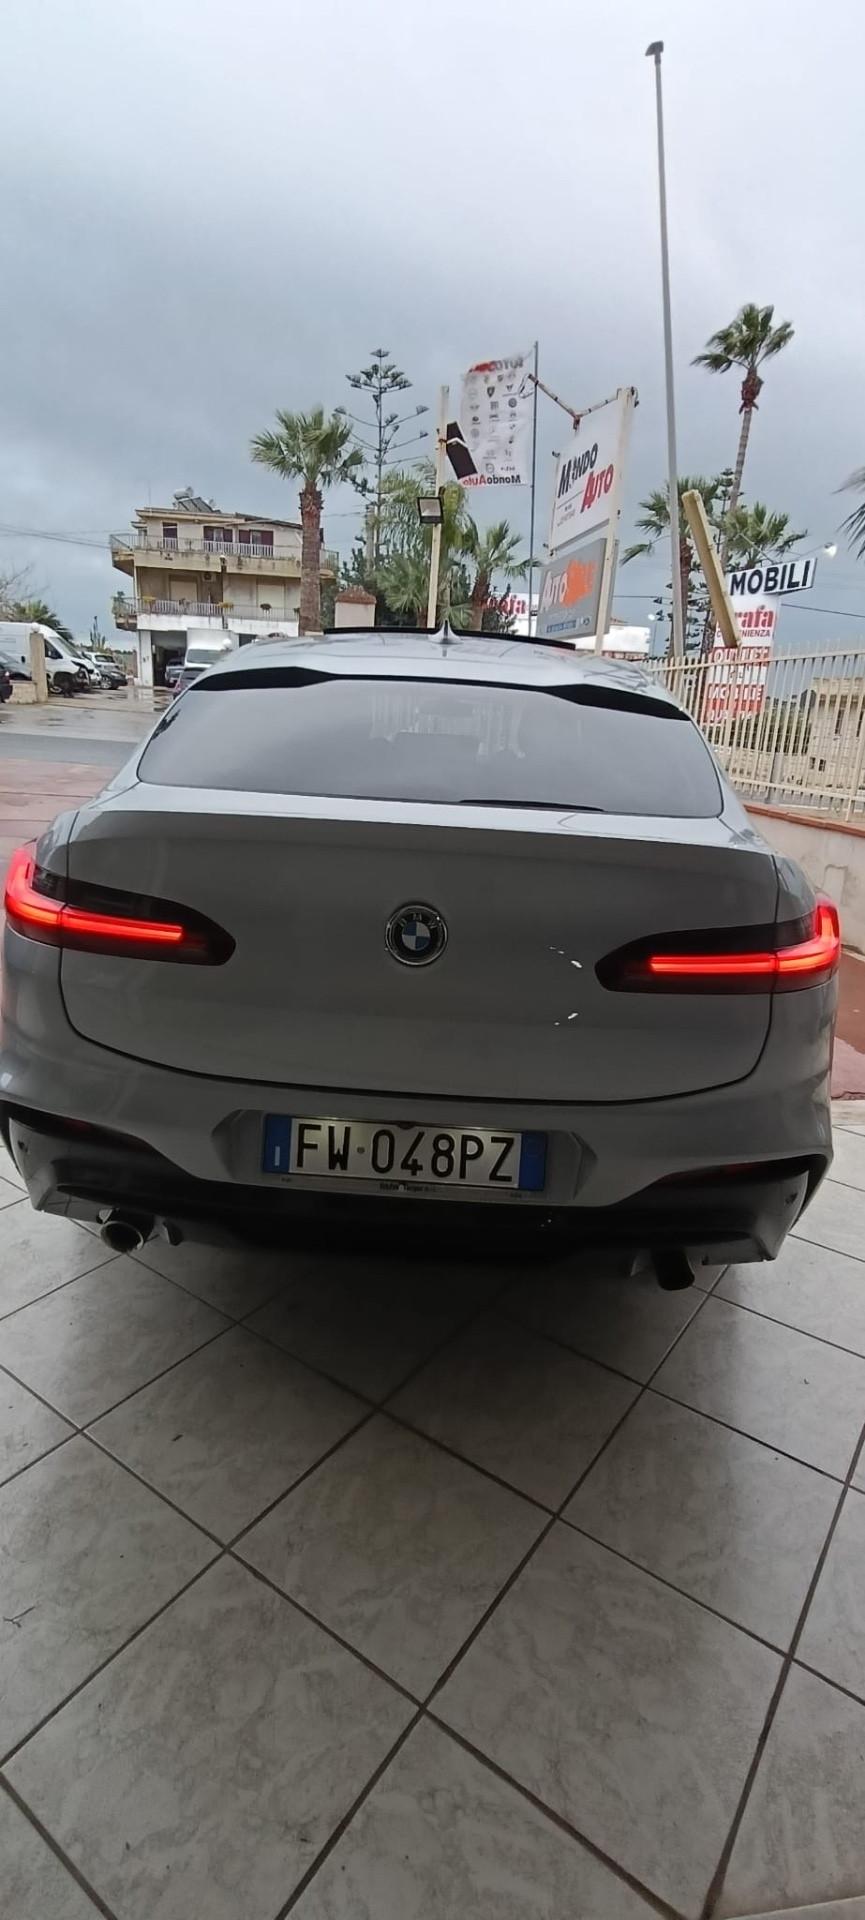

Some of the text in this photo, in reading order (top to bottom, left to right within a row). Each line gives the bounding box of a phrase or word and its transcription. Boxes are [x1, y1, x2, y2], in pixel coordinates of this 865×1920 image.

[580, 464, 614, 514] AUTO
[729, 560, 811, 597] MOBILI
[296, 1123, 515, 1182] FW 048PZ
